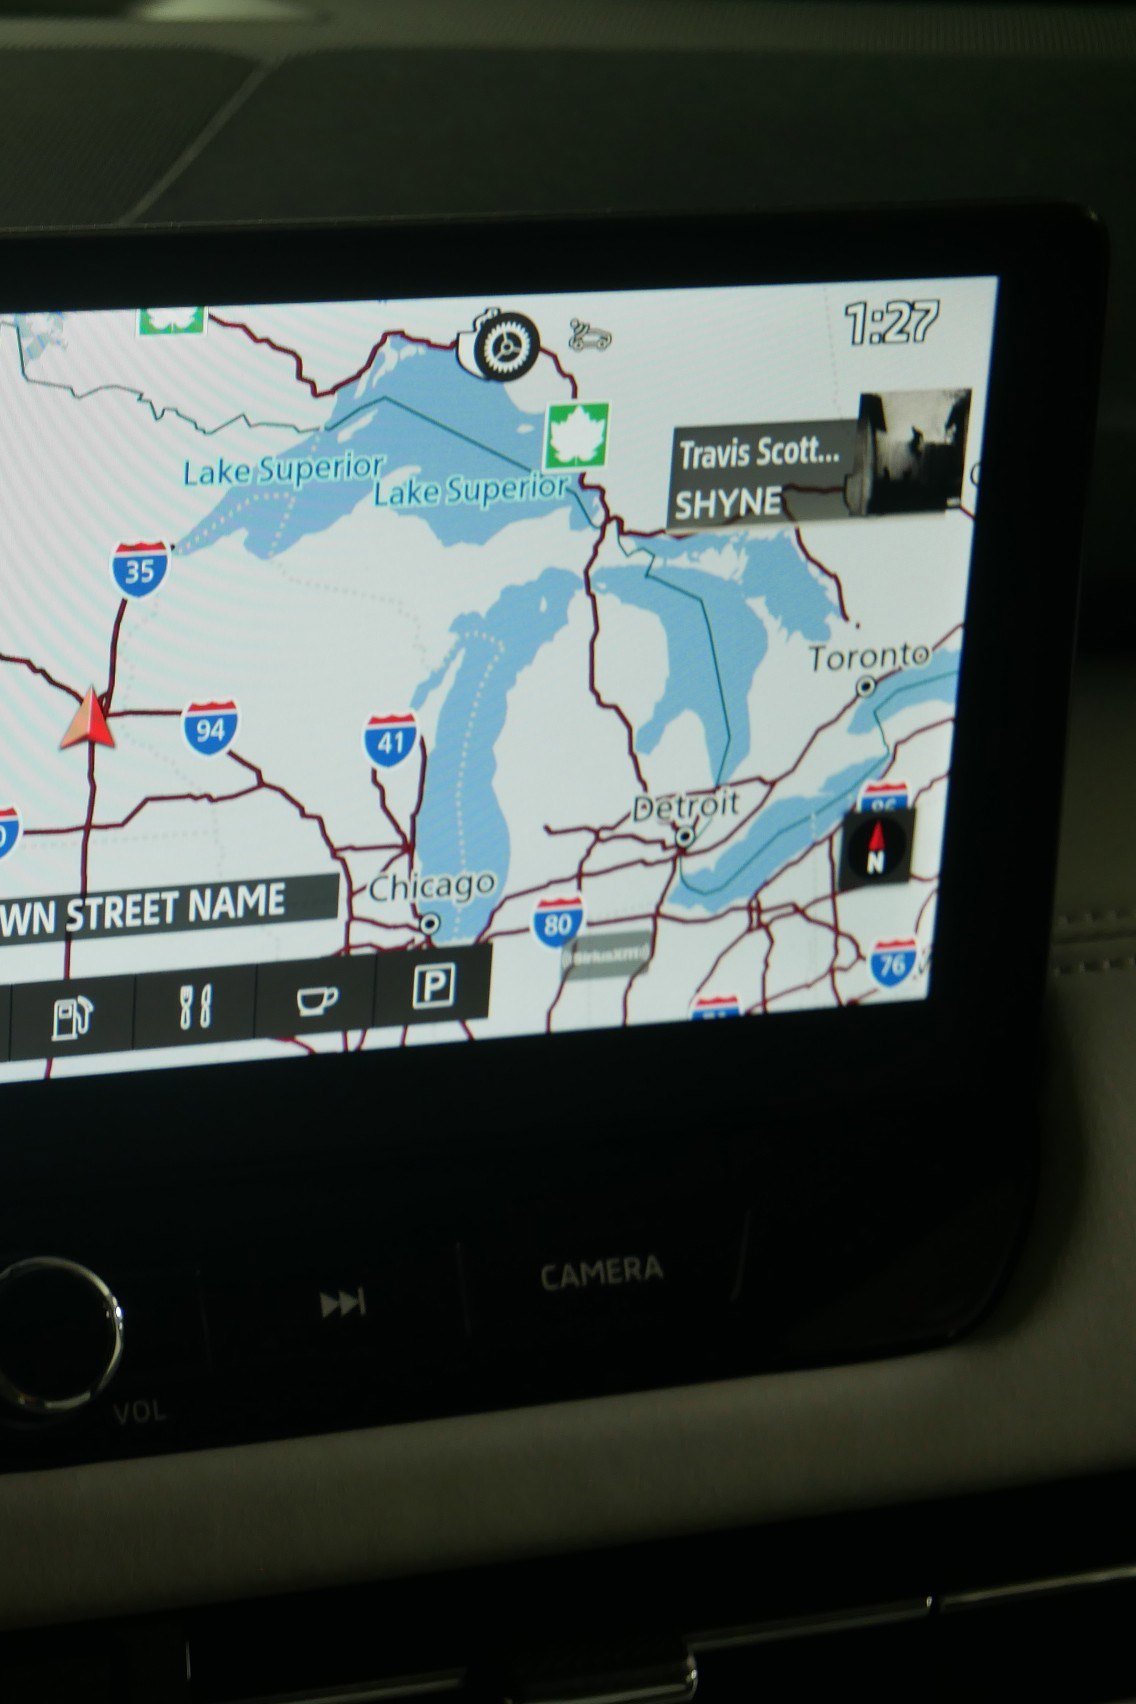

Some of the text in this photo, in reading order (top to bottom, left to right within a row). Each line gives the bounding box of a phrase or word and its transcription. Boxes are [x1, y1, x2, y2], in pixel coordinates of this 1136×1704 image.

[844, 300, 941, 345] 1:27
[679, 436, 841, 470] Travis Scott...
[184, 451, 385, 488] Lake Superior
[374, 473, 568, 508] Lake Superior
[675, 485, 783, 520] SHYNE
[125, 560, 154, 583] 35
[809, 642, 930, 672] Toronto
[195, 717, 225, 742] 94
[377, 730, 405, 754] 41
[633, 789, 740, 822] Detroit
[867, 851, 885, 874] N
[369, 873, 495, 902] Chicago
[65, 890, 180, 932] STREET
[188, 881, 286, 922] NAME
[544, 913, 572, 937] 80
[880, 953, 906, 977] 76
[541, 1254, 664, 1291] CAMERA
[112, 1399, 167, 1426] VOL
